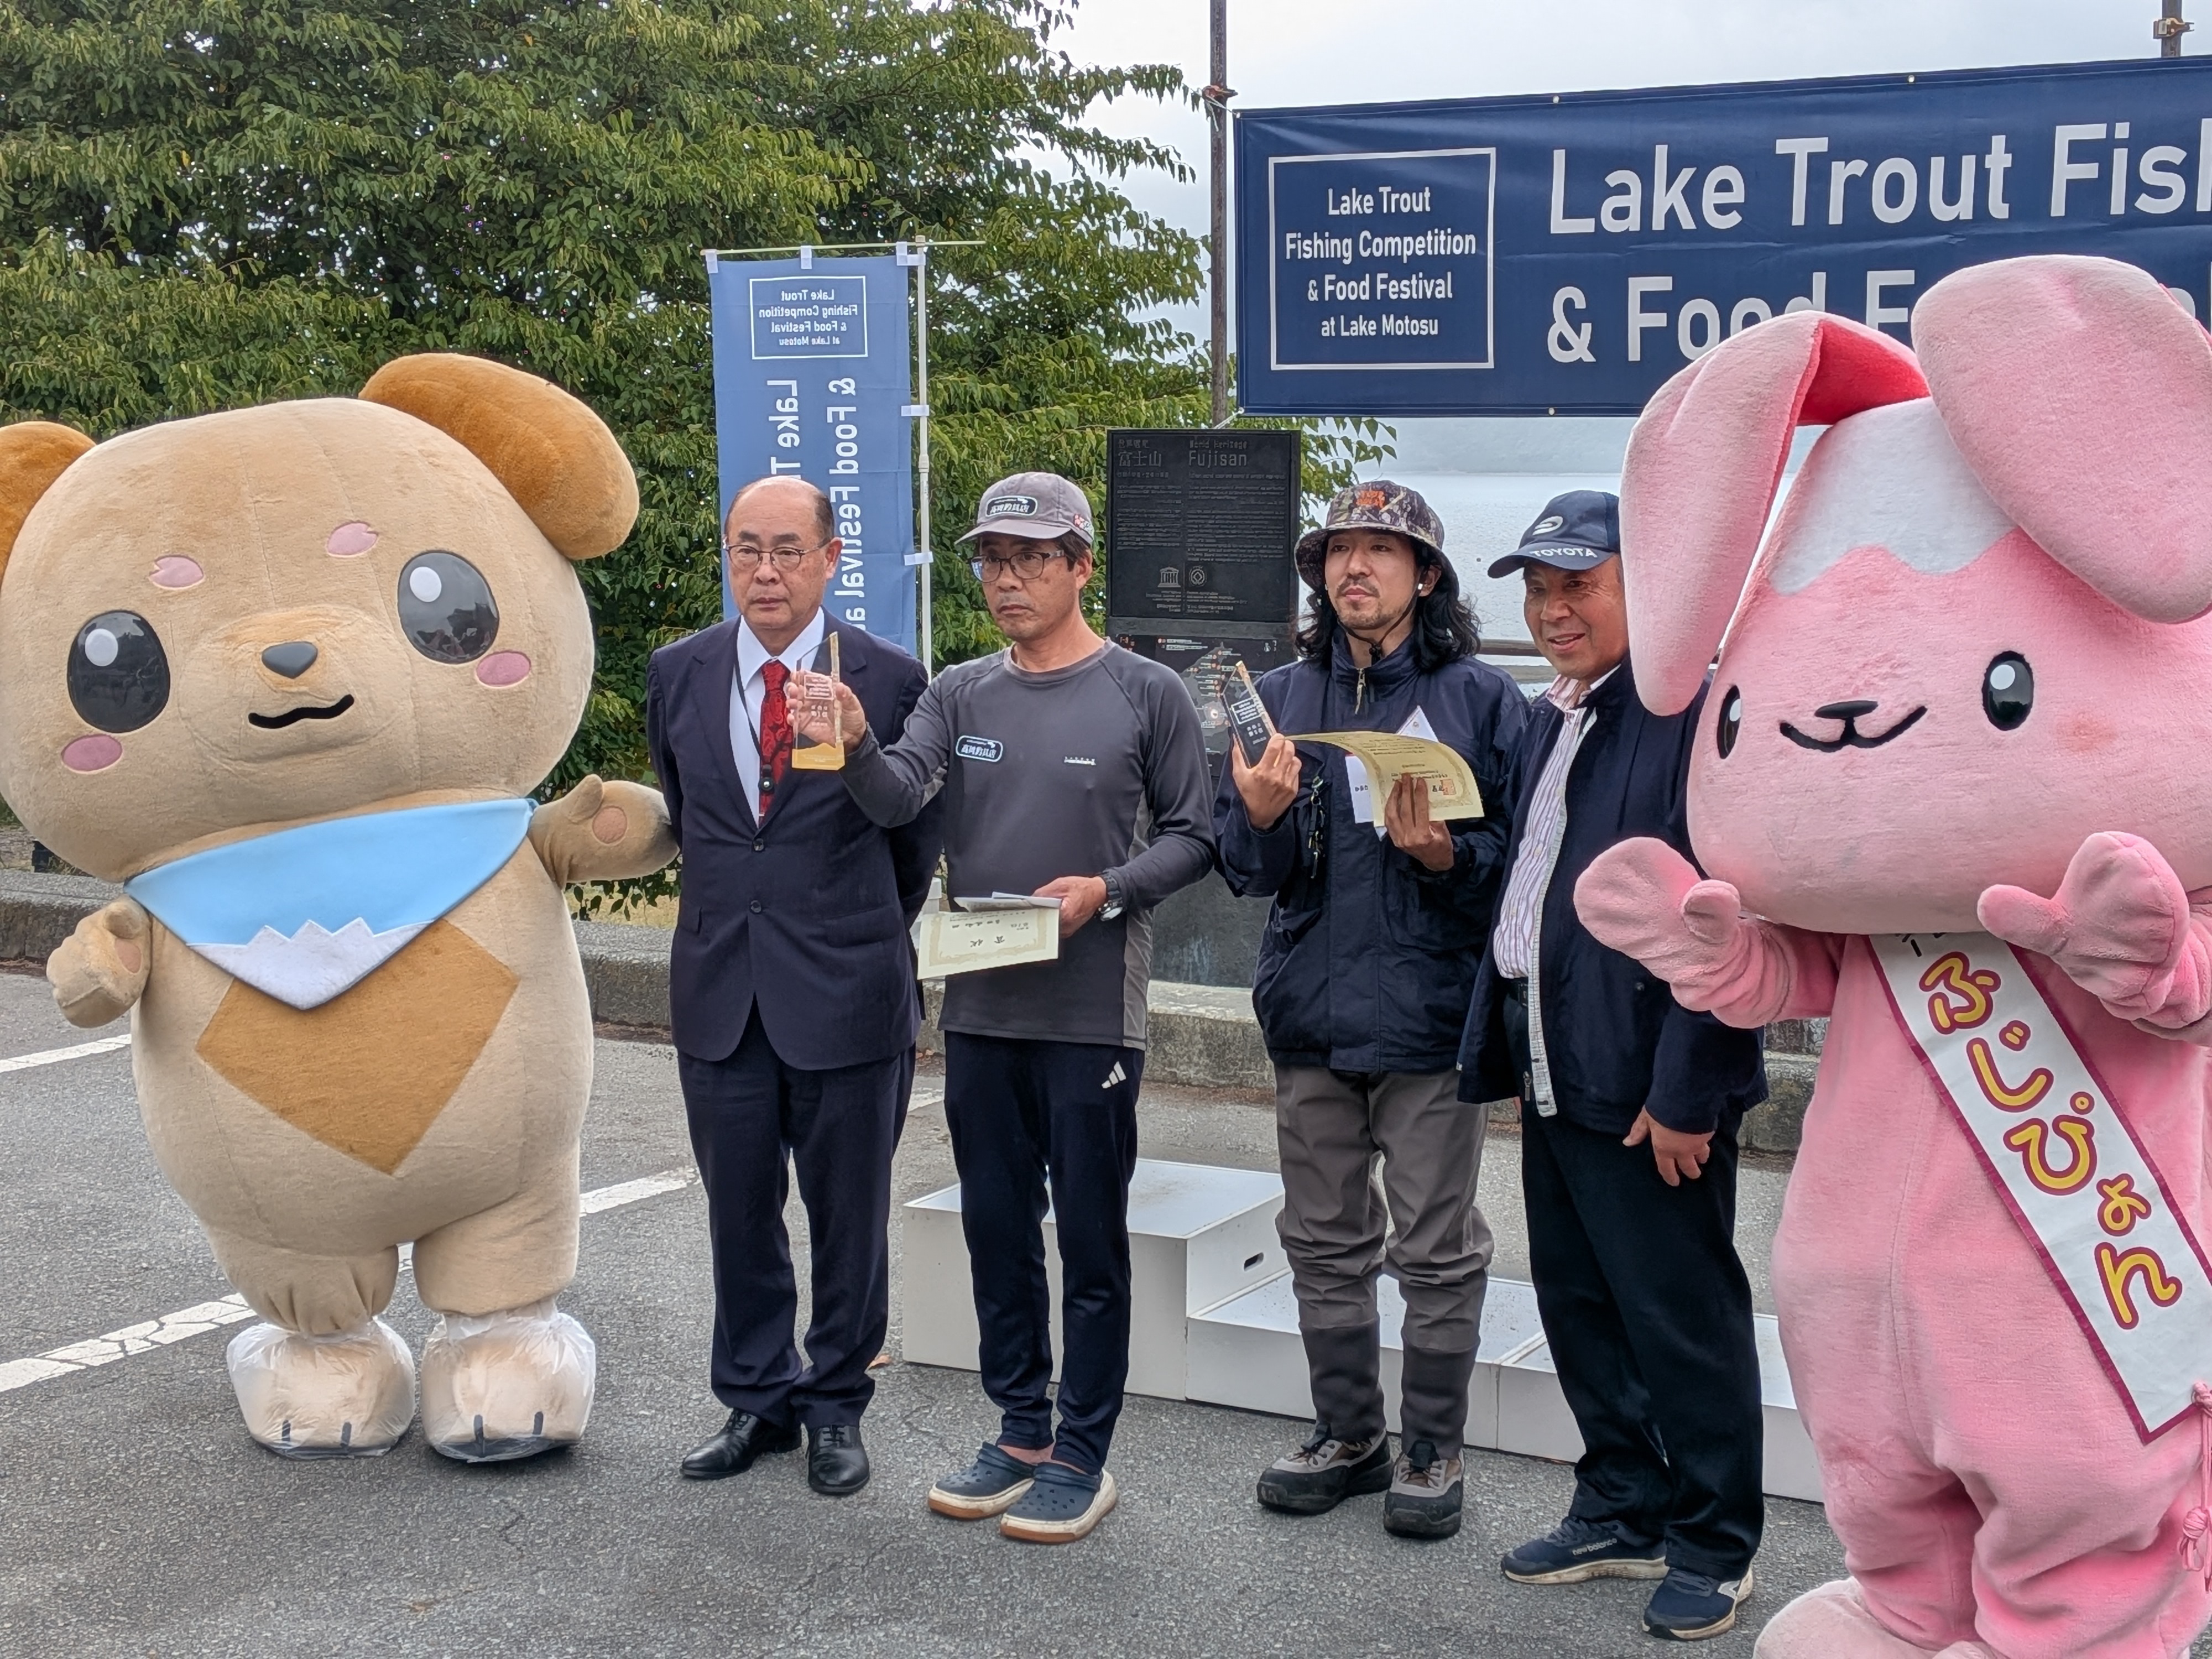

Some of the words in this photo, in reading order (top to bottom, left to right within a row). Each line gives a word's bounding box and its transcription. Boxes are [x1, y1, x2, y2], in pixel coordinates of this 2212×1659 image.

[1550, 144, 1745, 233] Lake
[1775, 134, 2012, 227] Trout
[1328, 188, 1374, 215] Lake
[1379, 186, 1431, 213] Trout
[1286, 232, 1352, 264] Fishing
[1359, 228, 1476, 263] Competition
[1307, 279, 1319, 301] &
[1324, 274, 1370, 301] Food
[1376, 272, 1453, 300] Festival
[1321, 316, 1335, 337] at
[1340, 315, 1376, 336] Lake
[1382, 314, 1438, 336] Motosu
[1547, 286, 1596, 362] &
[1118, 450, 1161, 467] 富士山
[1189, 450, 1247, 468] Fujisan
[1529, 547, 1598, 558] TOYOTA
[1919, 951, 2182, 1331] ふじぴょん
